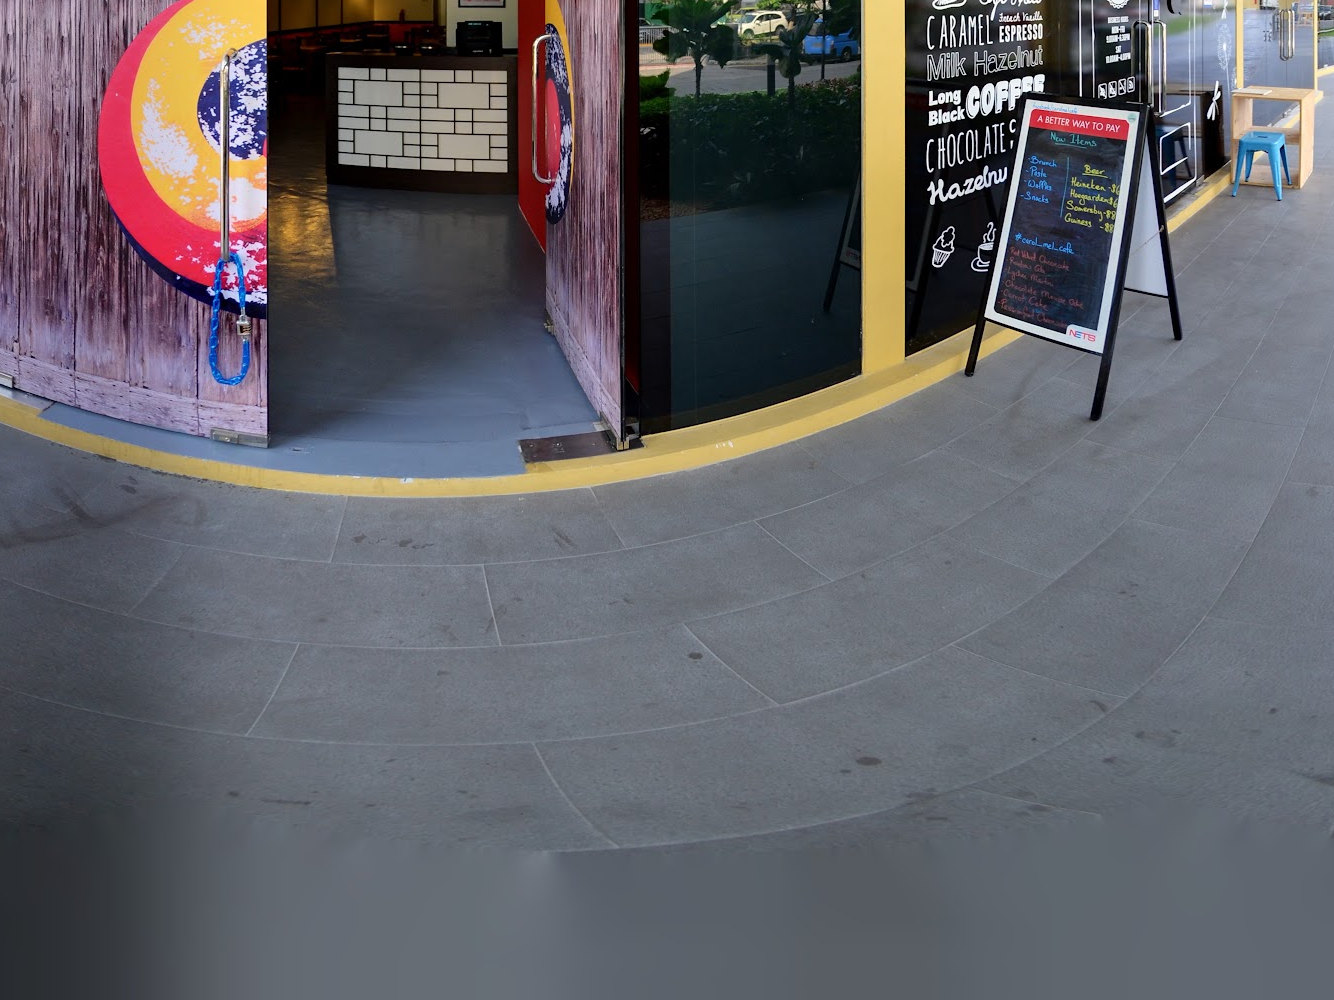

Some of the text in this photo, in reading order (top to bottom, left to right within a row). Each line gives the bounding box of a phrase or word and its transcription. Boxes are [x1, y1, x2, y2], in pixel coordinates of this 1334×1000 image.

[999, 11, 1043, 22] French Vanilla
[927, 14, 993, 50] CARAMEL
[999, 23, 1043, 43] ESPRESSO
[927, 45, 1043, 82] Milk Hazelnut
[928, 89, 961, 106] Long
[966, 74, 1046, 120] COFFEE
[928, 105, 965, 126] Black
[1037, 115, 1120, 133] A BETTER WAY TO PAY
[926, 122, 1006, 173] CHOCOLATE
[1050, 131, 1097, 147] New Items
[1071, 177, 1106, 192] Heineken
[1069, 329, 1097, 343] NETS
